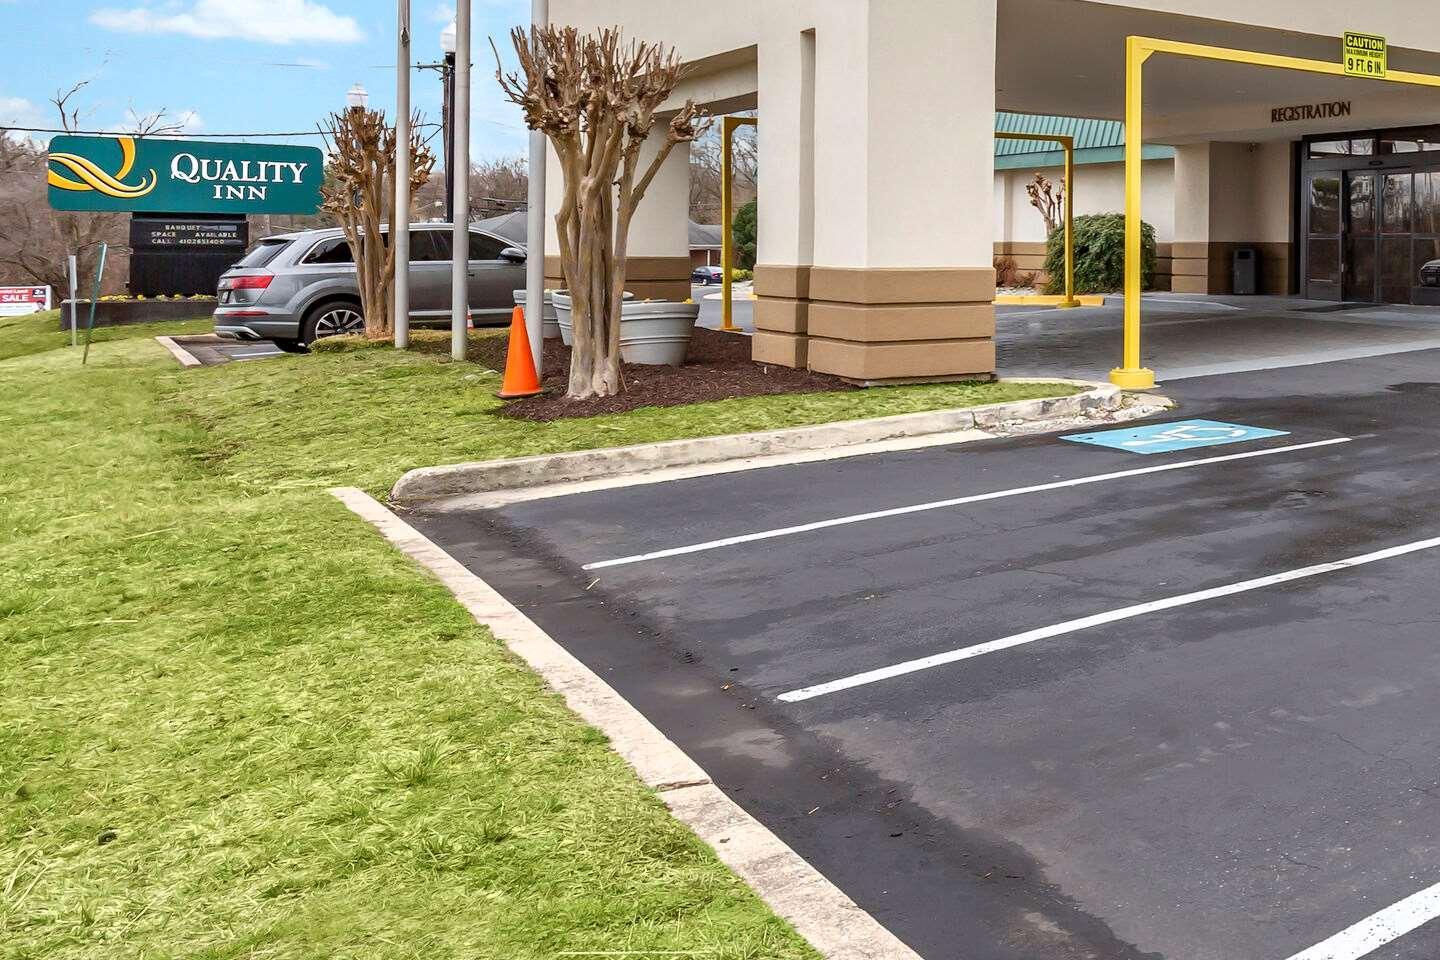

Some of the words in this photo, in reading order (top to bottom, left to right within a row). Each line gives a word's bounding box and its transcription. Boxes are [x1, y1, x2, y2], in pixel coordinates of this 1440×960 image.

[1347, 36, 1383, 50] CAUTION
[1348, 57, 1354, 70] 9
[1356, 59, 1366, 73] FT.
[1367, 60, 1373, 73] 6
[1271, 101, 1351, 123] REGISTRATION
[170, 153, 308, 183] QUALITY
[213, 184, 267, 200] INN
[1, 294, 29, 302] SALE
